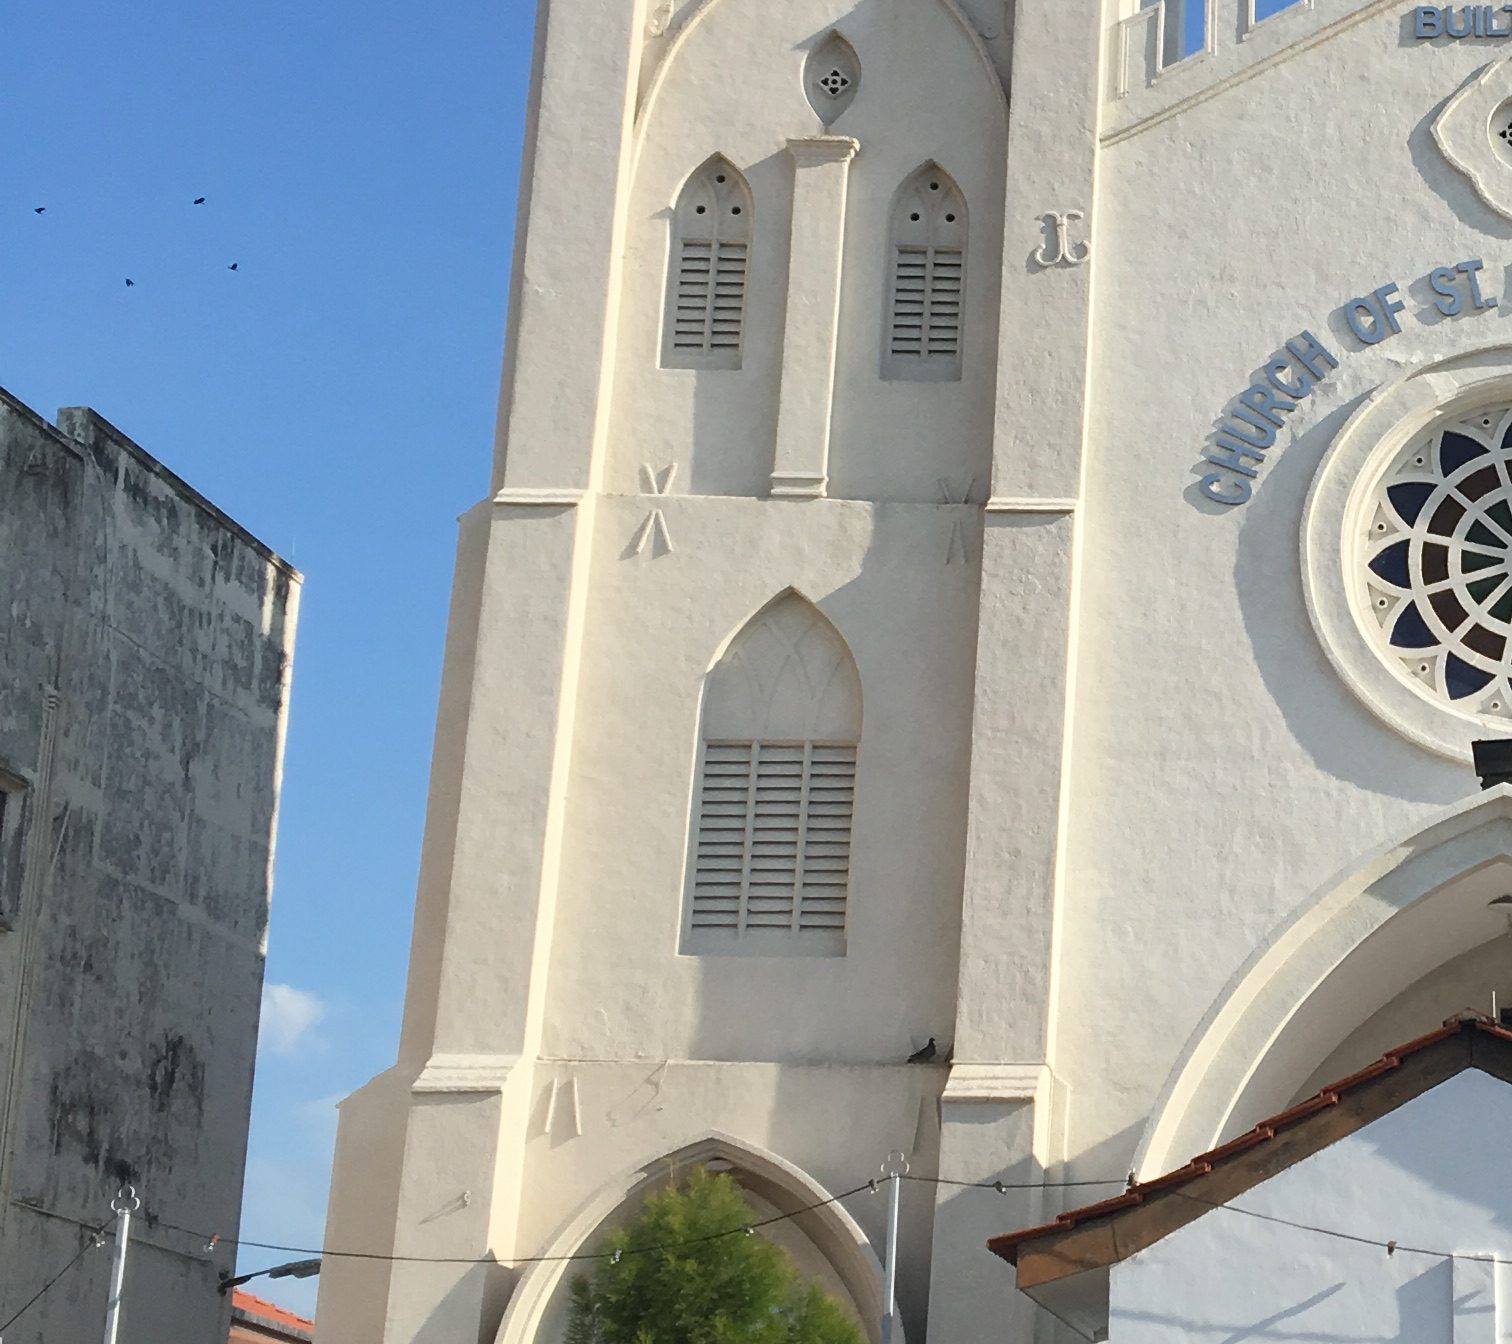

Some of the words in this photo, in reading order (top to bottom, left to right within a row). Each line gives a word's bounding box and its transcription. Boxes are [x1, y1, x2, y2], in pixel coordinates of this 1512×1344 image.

[1200, 329, 1340, 506] CHURCH
[1347, 281, 1406, 346] OF
[1430, 258, 1499, 317] ST.
